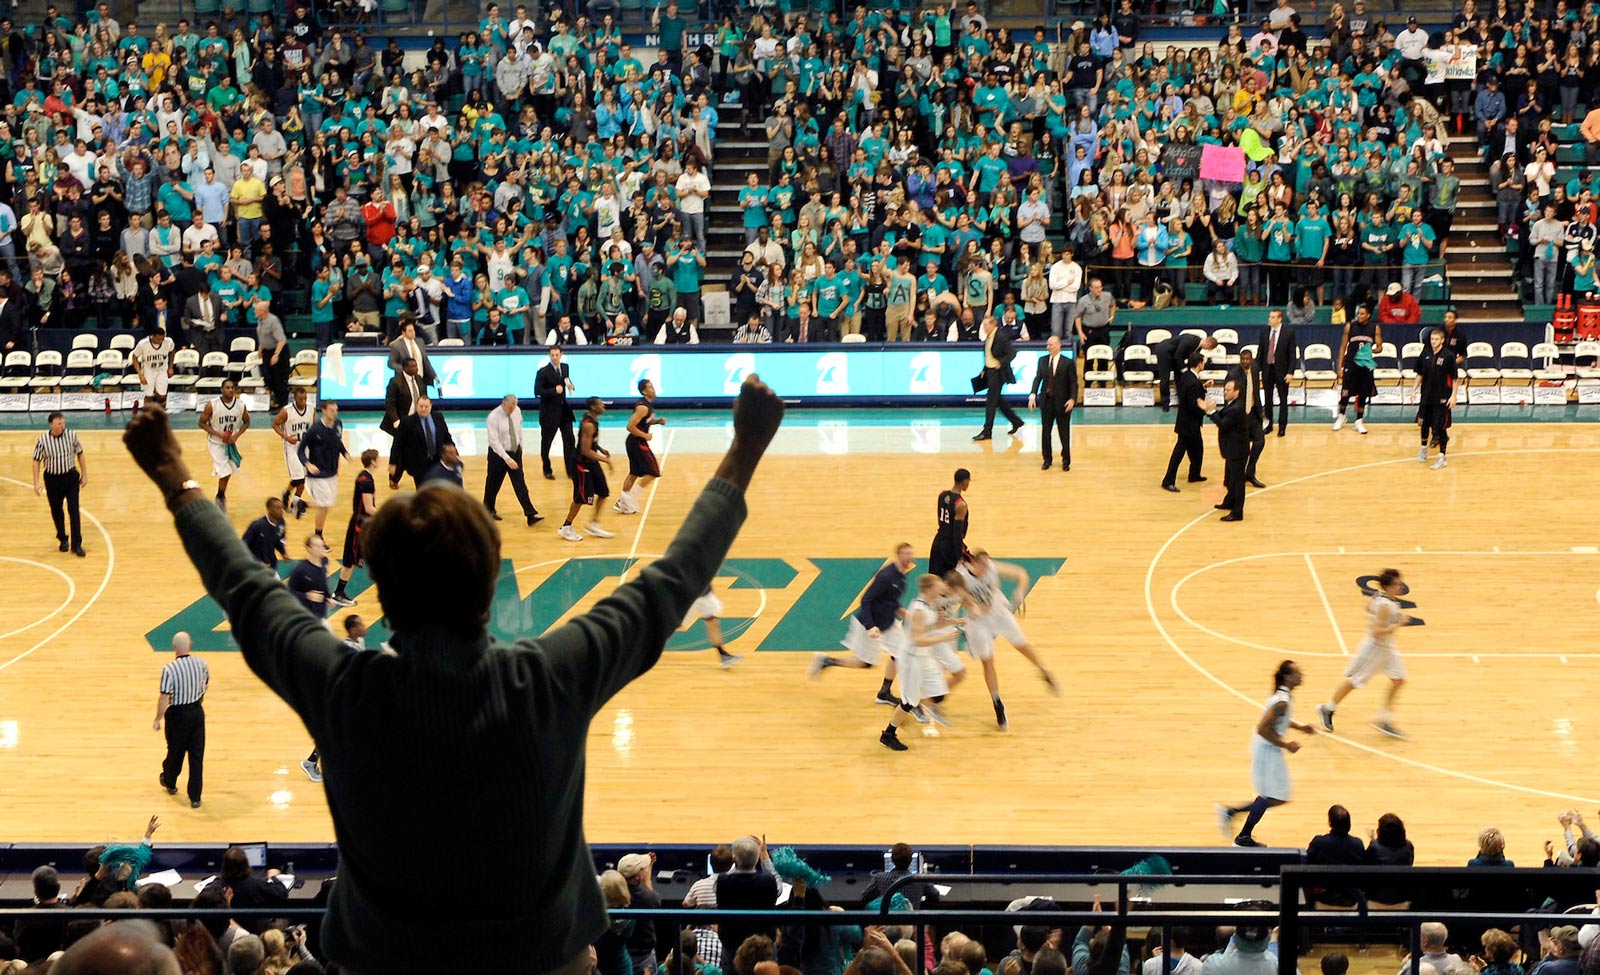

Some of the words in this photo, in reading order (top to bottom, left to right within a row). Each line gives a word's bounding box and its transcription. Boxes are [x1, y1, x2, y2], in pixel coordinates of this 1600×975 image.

[893, 284, 907, 303] A
[969, 279, 982, 298] S
[147, 354, 168, 362] UNCW
[219, 415, 237, 424] UNCW
[939, 507, 951, 524] 12
